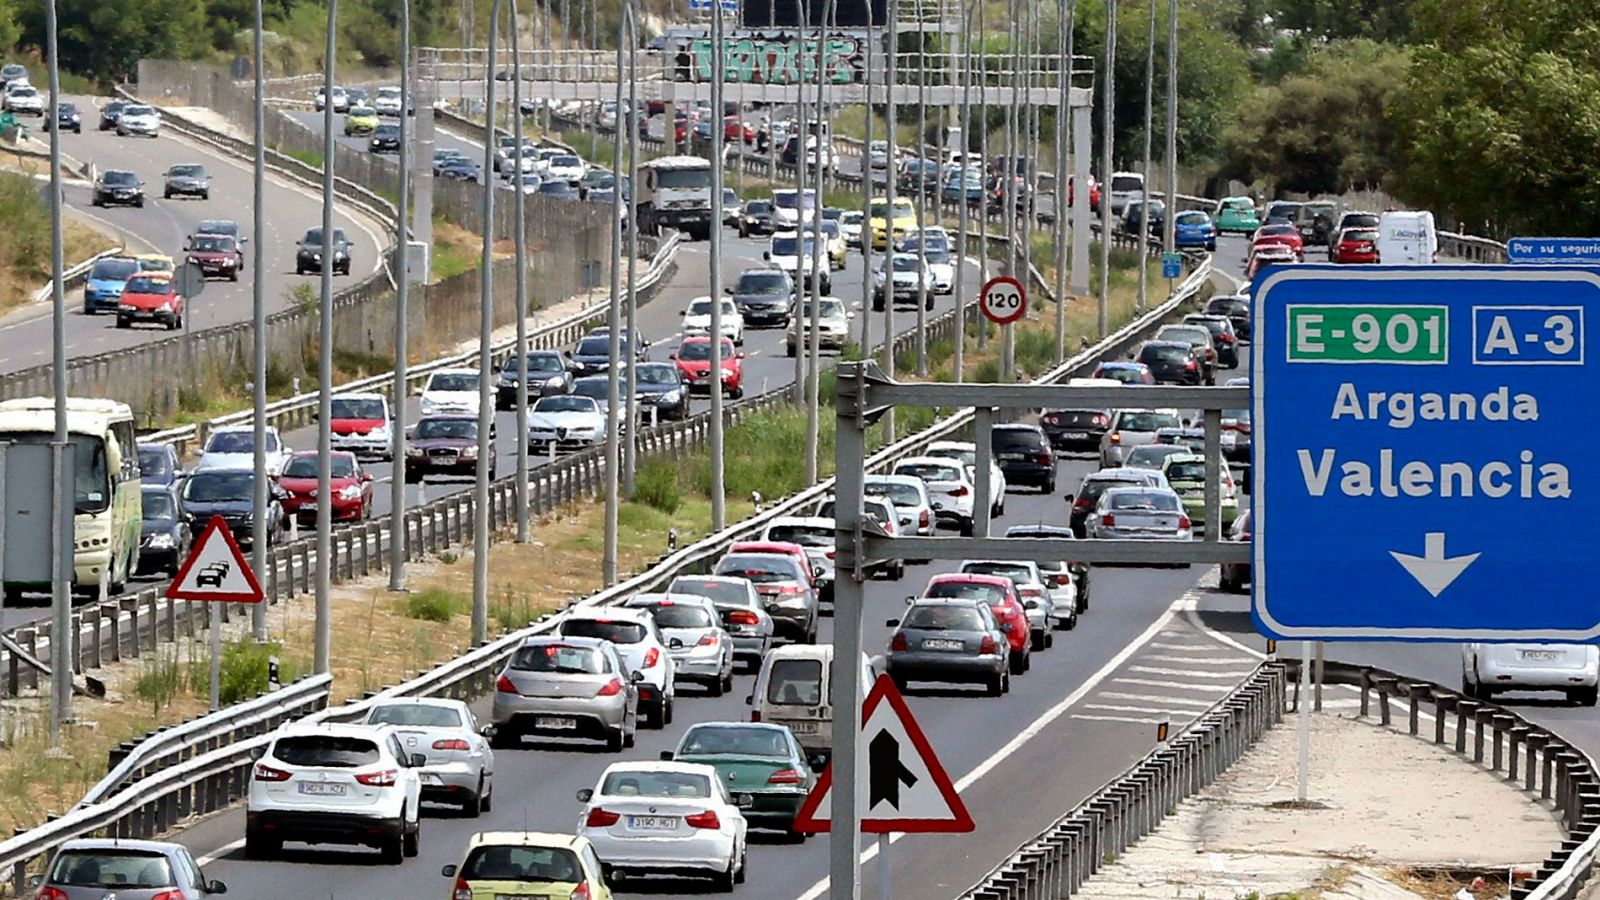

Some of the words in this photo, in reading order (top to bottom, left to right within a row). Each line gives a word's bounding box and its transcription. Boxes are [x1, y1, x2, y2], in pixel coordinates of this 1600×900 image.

[1513, 242, 1533, 253] Por
[1540, 245, 1554, 253] su
[988, 293, 1020, 308] 120
[1295, 313, 1441, 355] E-901
[1482, 314, 1575, 355] A-3
[1331, 382, 1539, 429] Arganda
[1296, 448, 1572, 499] Valencia
